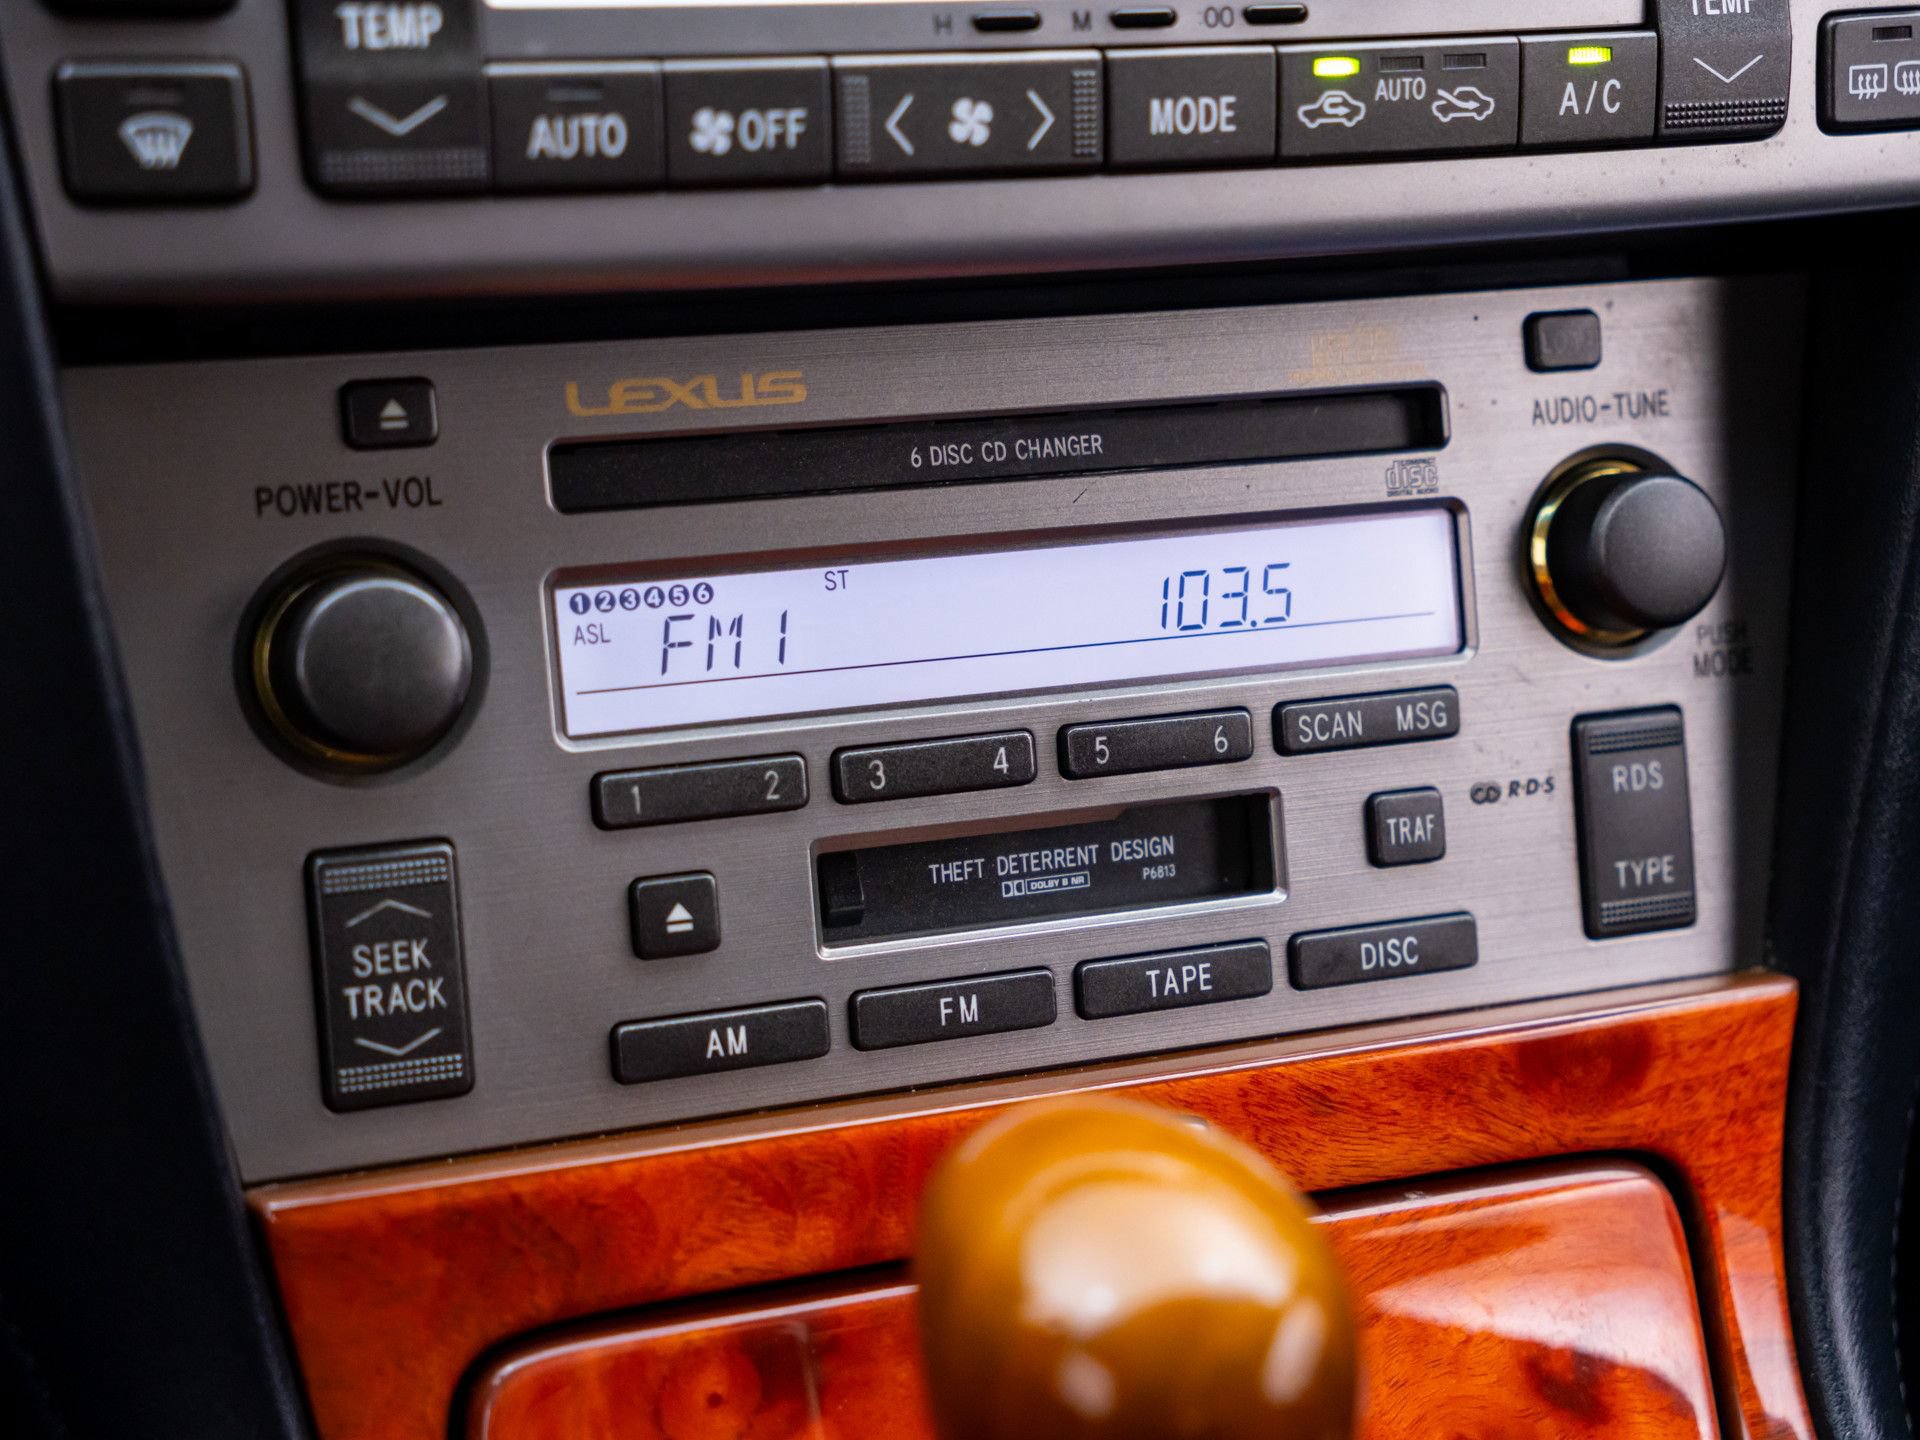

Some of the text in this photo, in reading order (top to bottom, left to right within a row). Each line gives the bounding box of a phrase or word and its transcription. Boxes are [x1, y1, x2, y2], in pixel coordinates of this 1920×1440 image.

[336, 3, 443, 49] TEMP
[933, 15, 953, 34] H
[1071, 11, 1092, 31] M
[1374, 76, 1427, 102] AUTO
[1559, 78, 1621, 116] A/C
[738, 108, 807, 151] OFF
[1150, 95, 1237, 135] MODE
[528, 113, 628, 158] AUTO
[565, 370, 806, 417] LEXUS
[1532, 390, 1670, 425] AUDIO-TUNE
[910, 434, 1103, 468] 6 DISC CD CHANGER
[254, 476, 443, 518] POWER-VOL
[824, 569, 849, 591] ST
[1161, 562, 1292, 632] 103.5
[574, 623, 611, 646] ASL
[1298, 700, 1447, 743] SCAN MSG
[1095, 725, 1229, 765] 5 6
[869, 746, 1009, 790] 3 4
[1612, 760, 1664, 792] RDS
[631, 770, 780, 814] 1 2
[1386, 813, 1435, 845] TRAF
[928, 835, 1175, 884] THEFT DETERRENT DESIGN
[1142, 863, 1176, 880] P6813
[1615, 855, 1674, 888] TYPE
[1030, 875, 1086, 890] DOLBY B NR
[352, 937, 433, 978] SEEK
[1359, 935, 1420, 972] DISC
[342, 975, 448, 1021] TRACK
[1144, 961, 1214, 999] TAPE
[939, 994, 979, 1026] FM
[706, 1025, 748, 1059] AM
